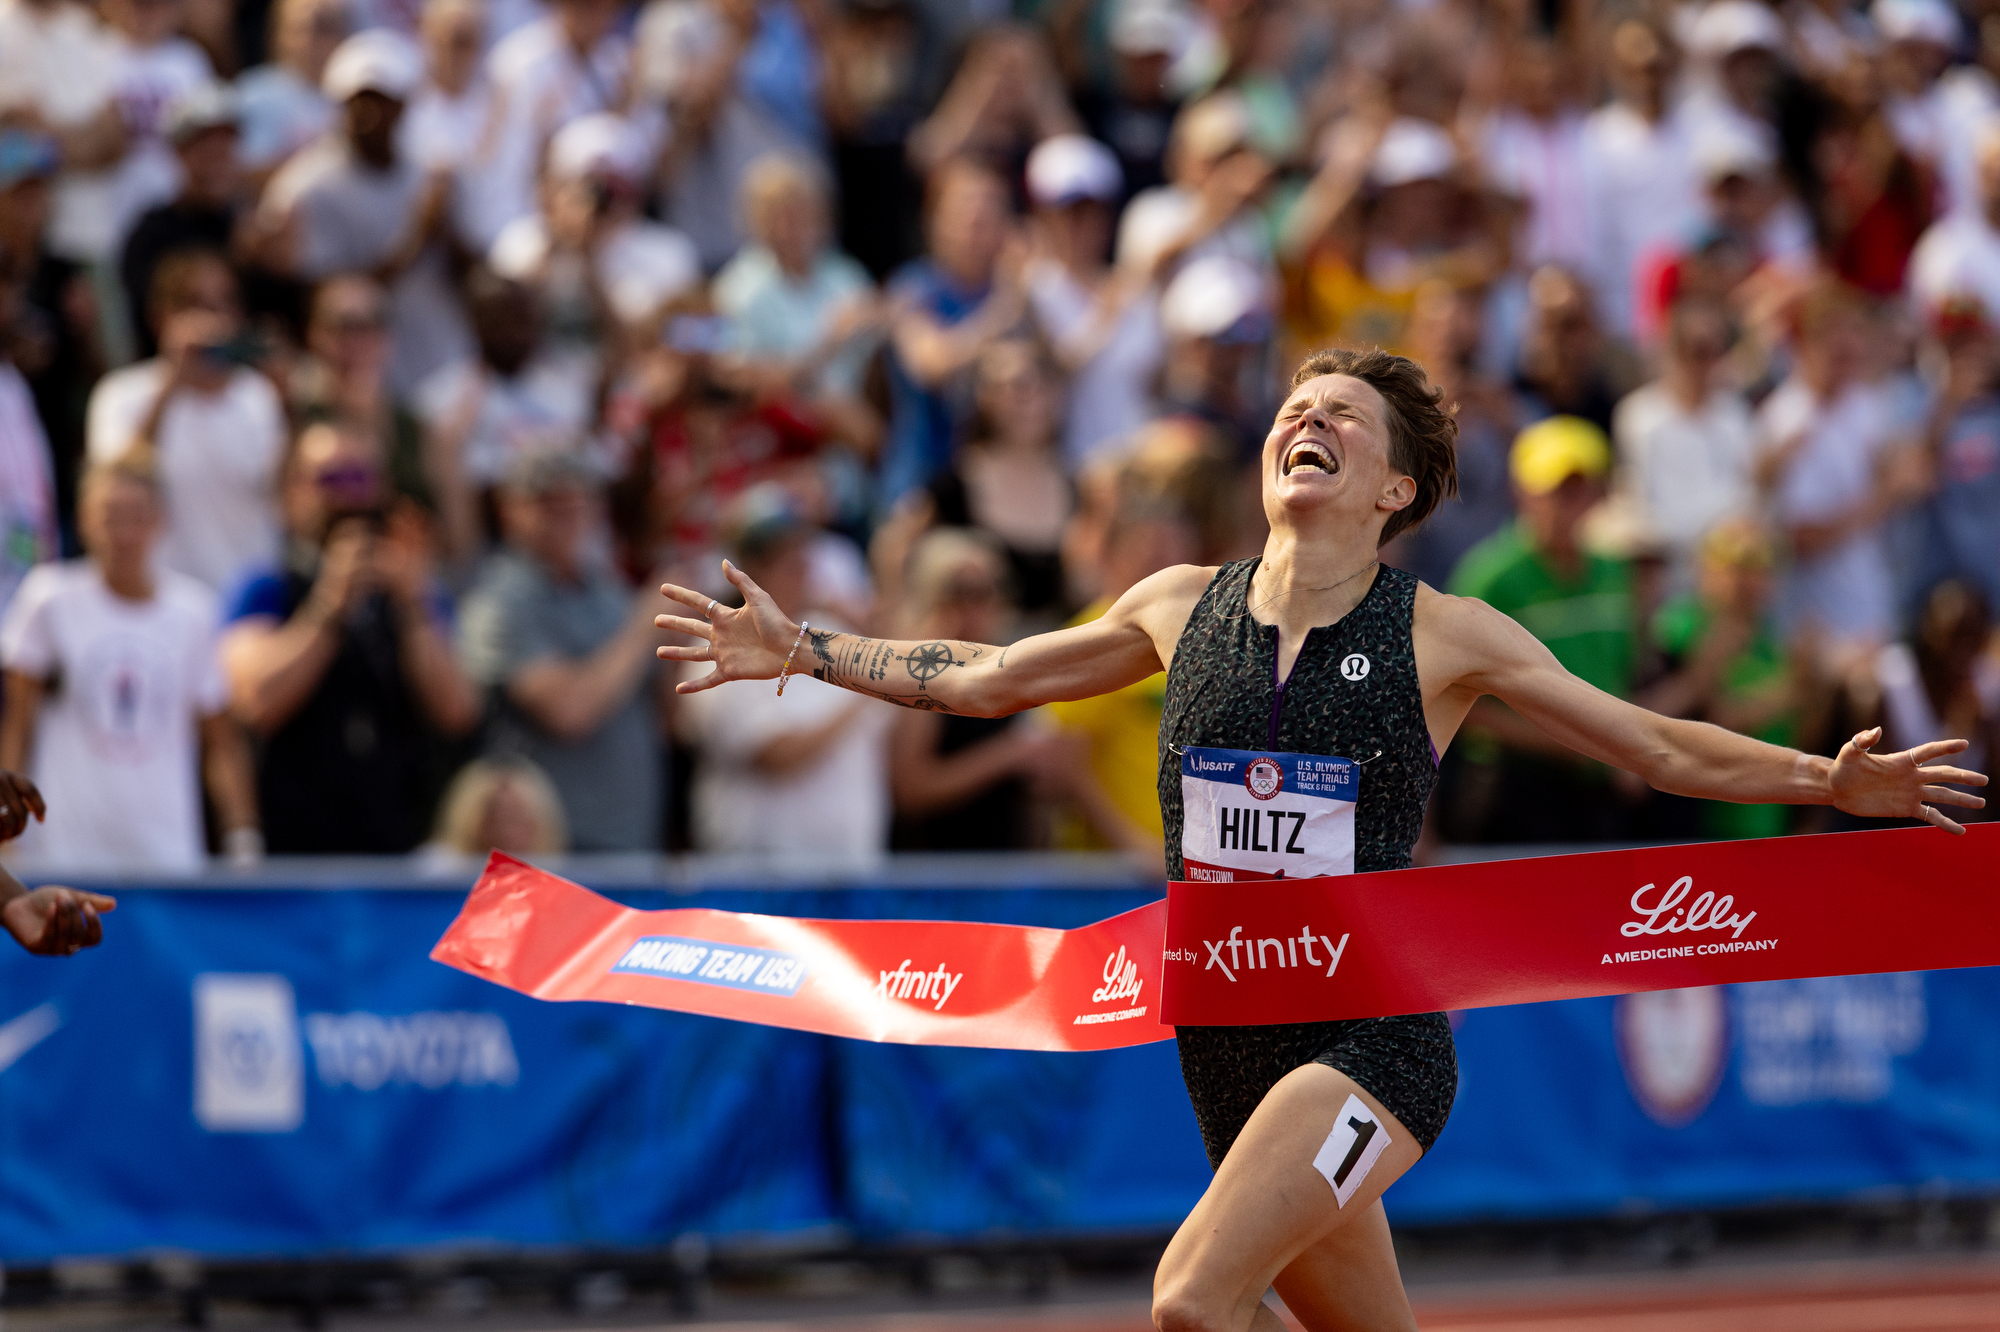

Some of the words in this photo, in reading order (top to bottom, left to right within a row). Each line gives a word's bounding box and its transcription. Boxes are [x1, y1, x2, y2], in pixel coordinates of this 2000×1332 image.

[1202, 761, 1236, 772] USATF
[1296, 771, 1319, 782] TEAM
[1321, 773, 1350, 785] TRIALS
[1297, 760, 1313, 771] U.S.
[1315, 762, 1350, 774] OLYMPIC
[1297, 782, 1315, 790] TRACK
[1321, 784, 1336, 792] FIELD
[1220, 806, 1306, 854] HILTZ
[1189, 866, 1234, 883] TRACKTOWN
[1620, 876, 1757, 939] Lilly
[619, 940, 706, 975] MAKING
[700, 949, 759, 984] TEAM
[757, 956, 805, 990] USA
[1184, 948, 1198, 966] by
[1203, 925, 1350, 982] xfinity
[1601, 954, 1613, 965] A
[1615, 946, 1694, 963] MEDICINE
[1696, 939, 1779, 955] COMPANY
[873, 959, 963, 1011] xfinity
[1092, 945, 1143, 1006] Lilly
[1073, 1015, 1081, 1025] A
[1080, 1012, 1117, 1025] MEDICINE
[1116, 1006, 1147, 1021] COMPANY
[1333, 1115, 1378, 1190] 1
